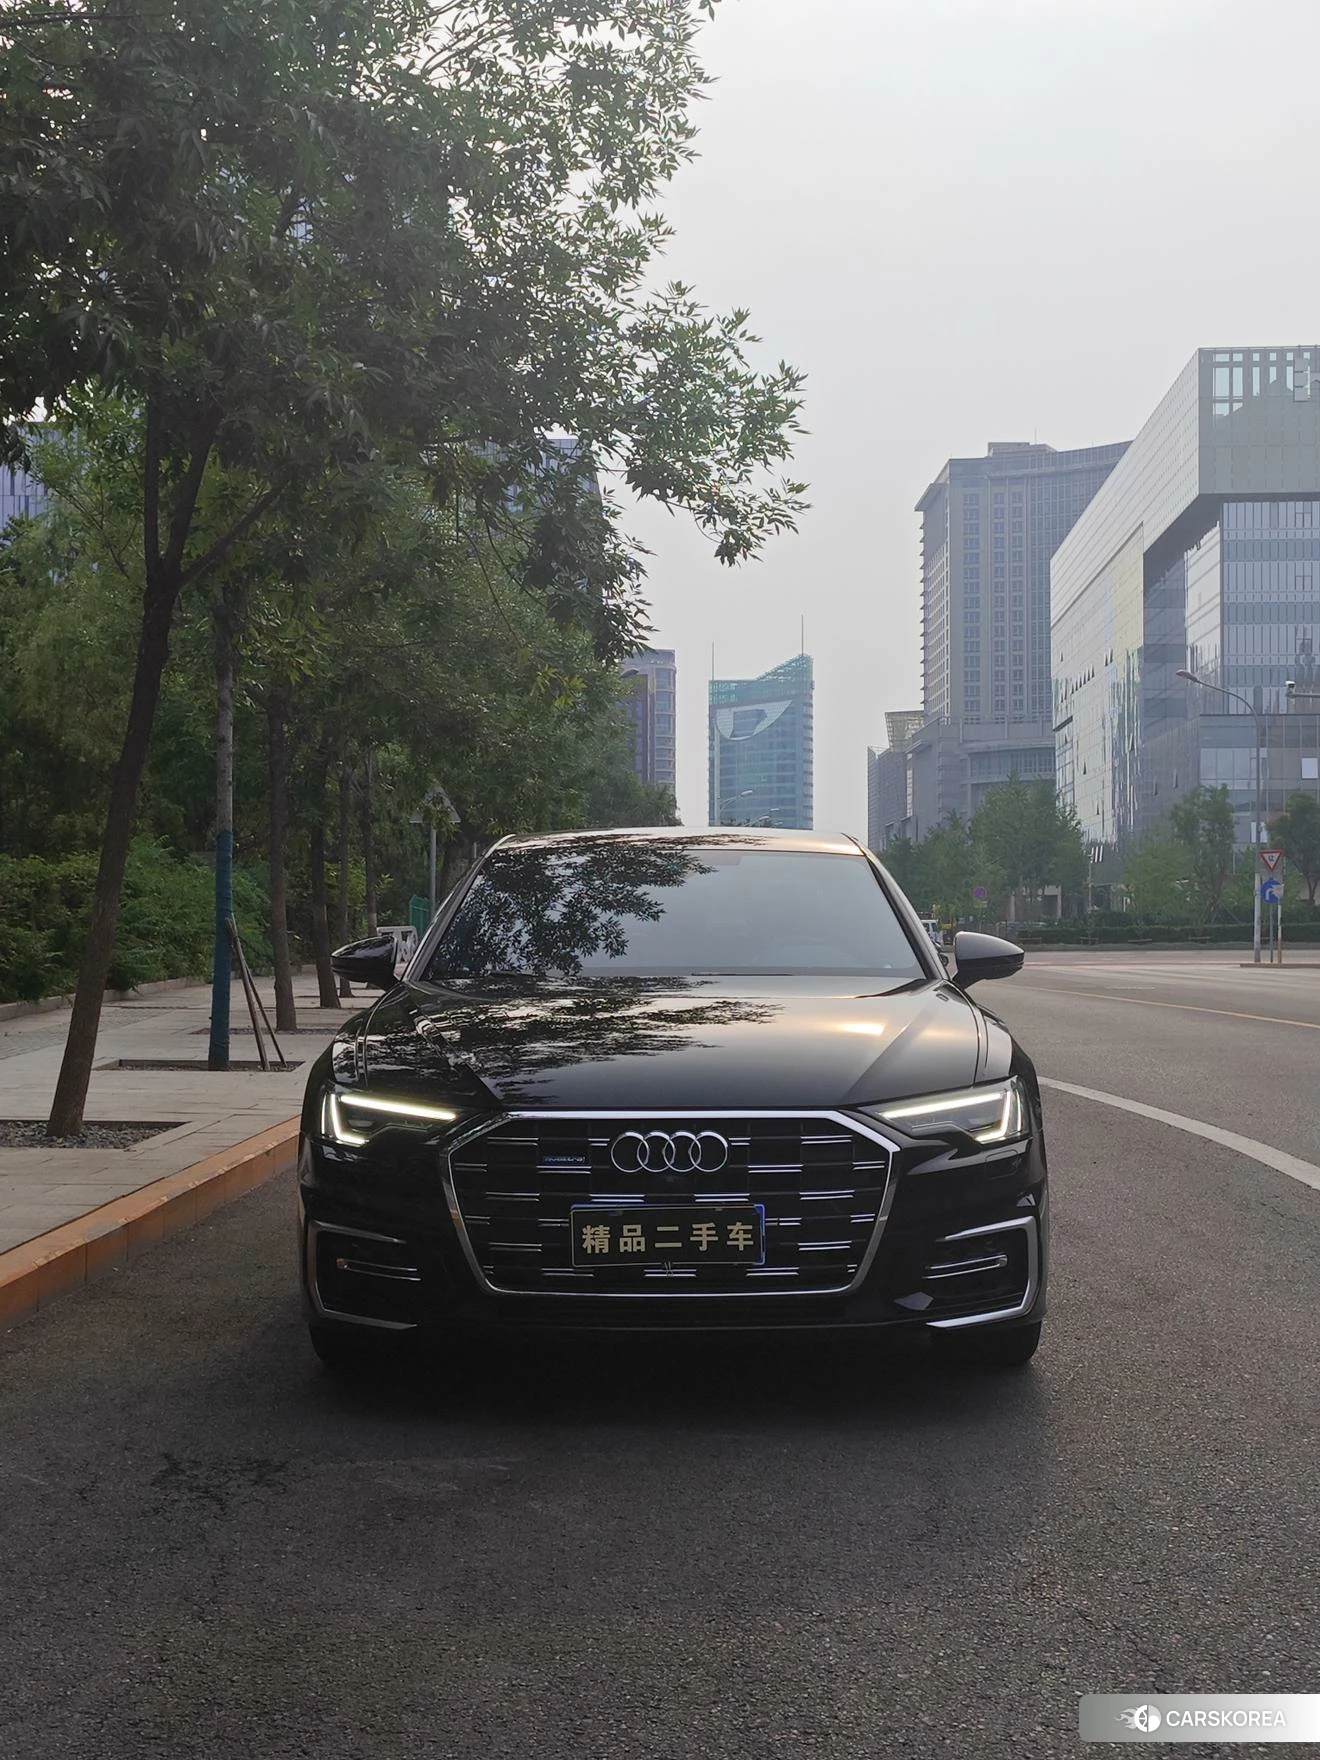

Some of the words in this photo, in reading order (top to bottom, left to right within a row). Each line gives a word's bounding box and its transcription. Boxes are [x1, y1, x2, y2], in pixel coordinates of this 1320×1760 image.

[582, 1222, 754, 1254] 精品二手车
